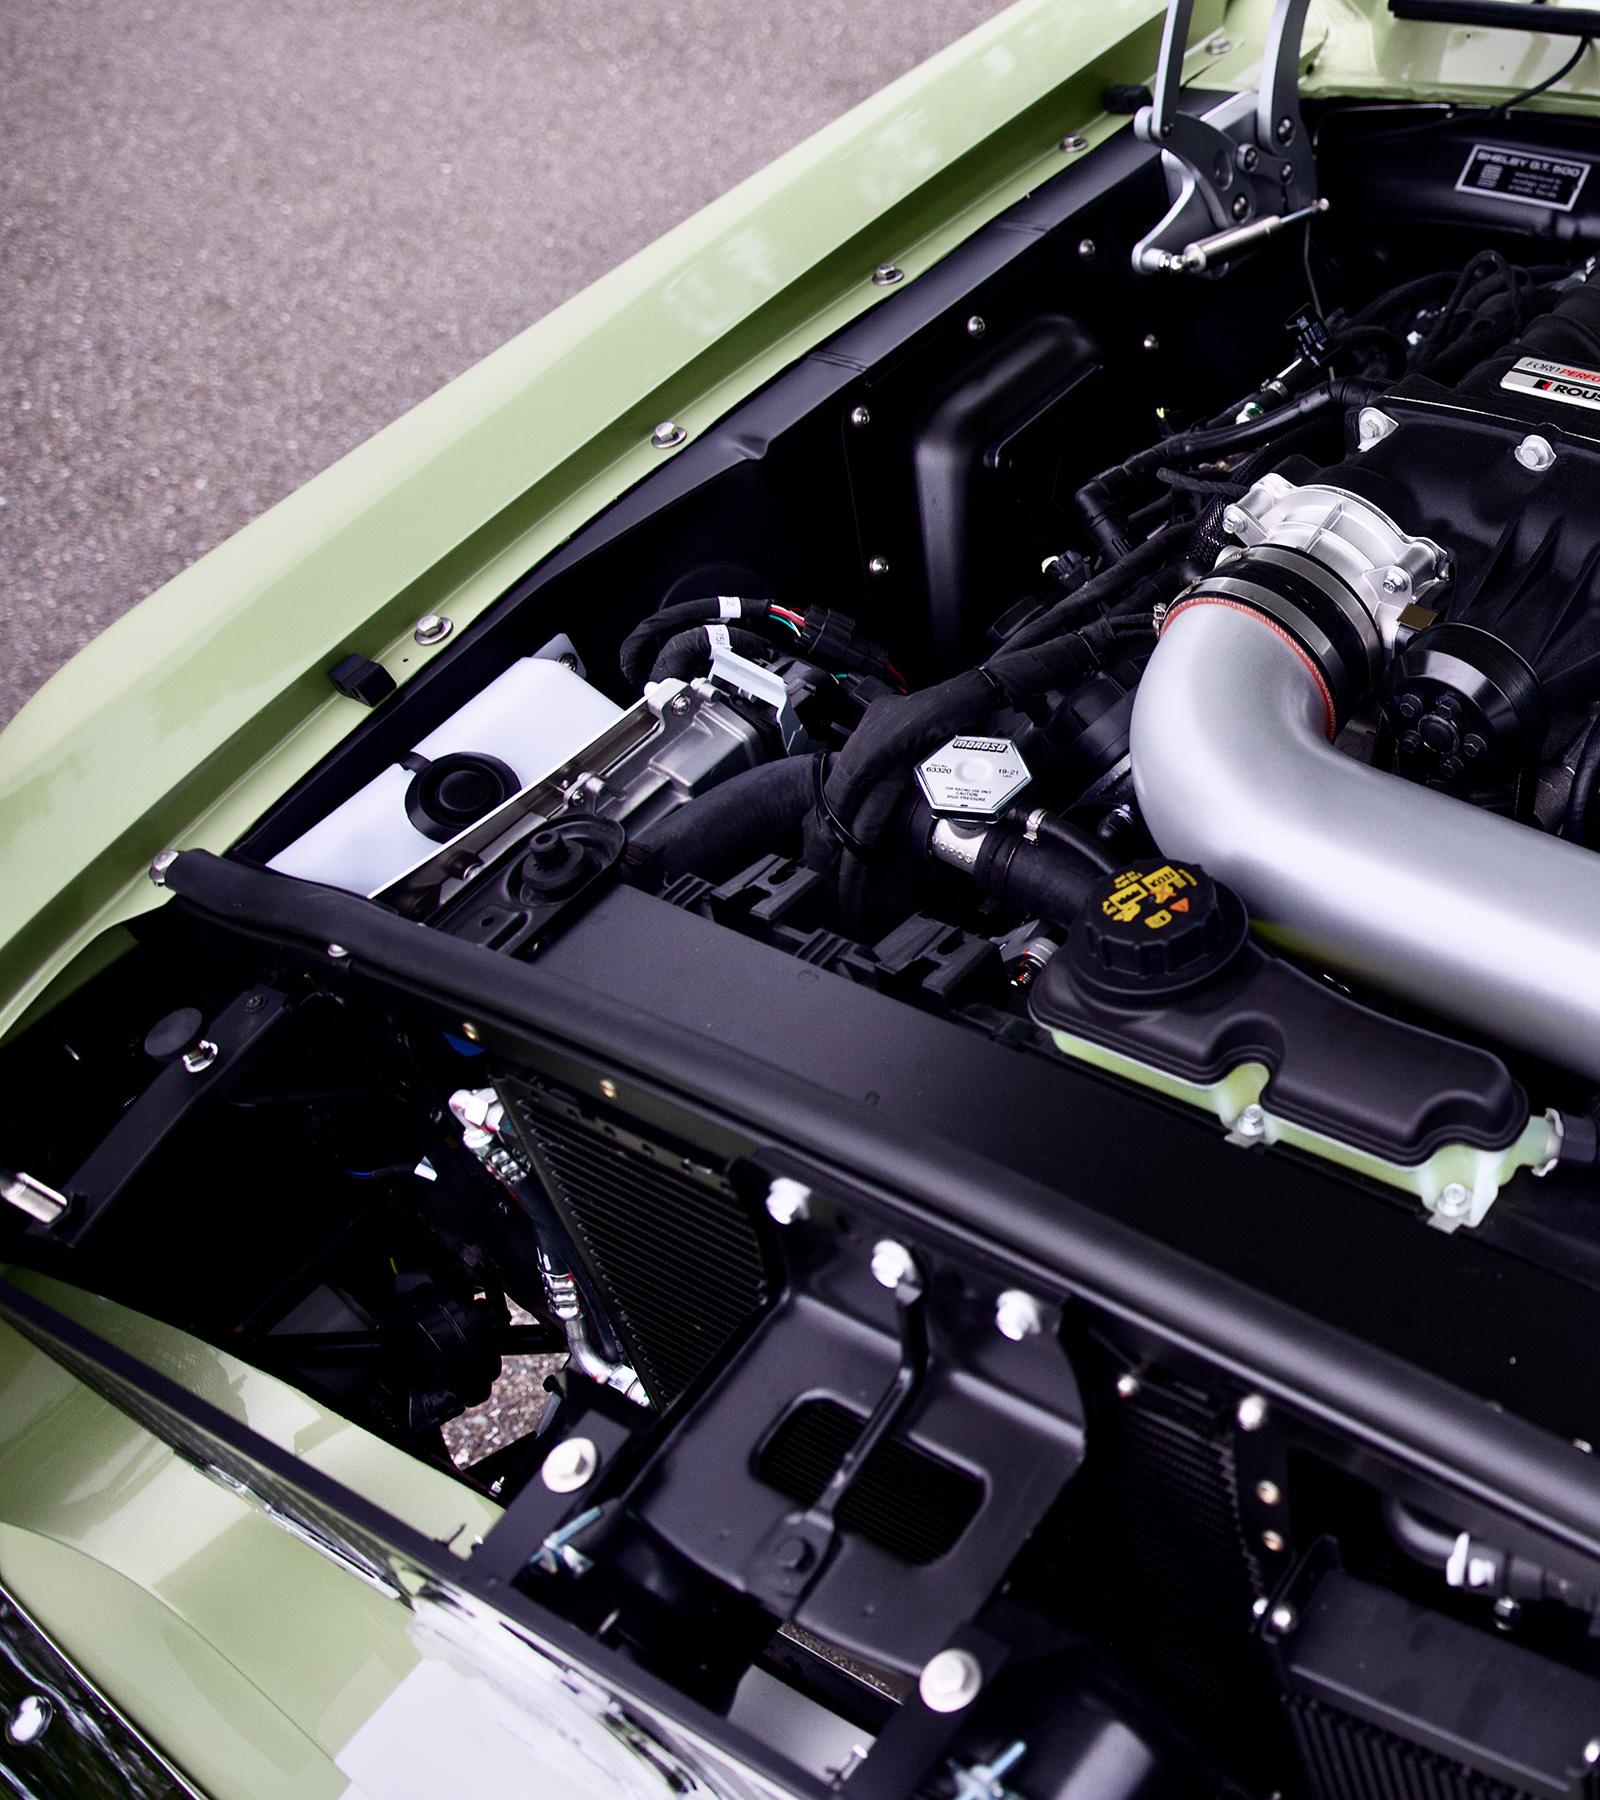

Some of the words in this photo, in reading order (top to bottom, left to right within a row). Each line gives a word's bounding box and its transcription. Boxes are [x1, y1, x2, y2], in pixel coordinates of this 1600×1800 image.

[1477, 152, 1529, 167] SHELBY
[1552, 164, 1581, 178] 500
[1526, 360, 1560, 374] FORD
[952, 740, 1008, 753] MOROSO
